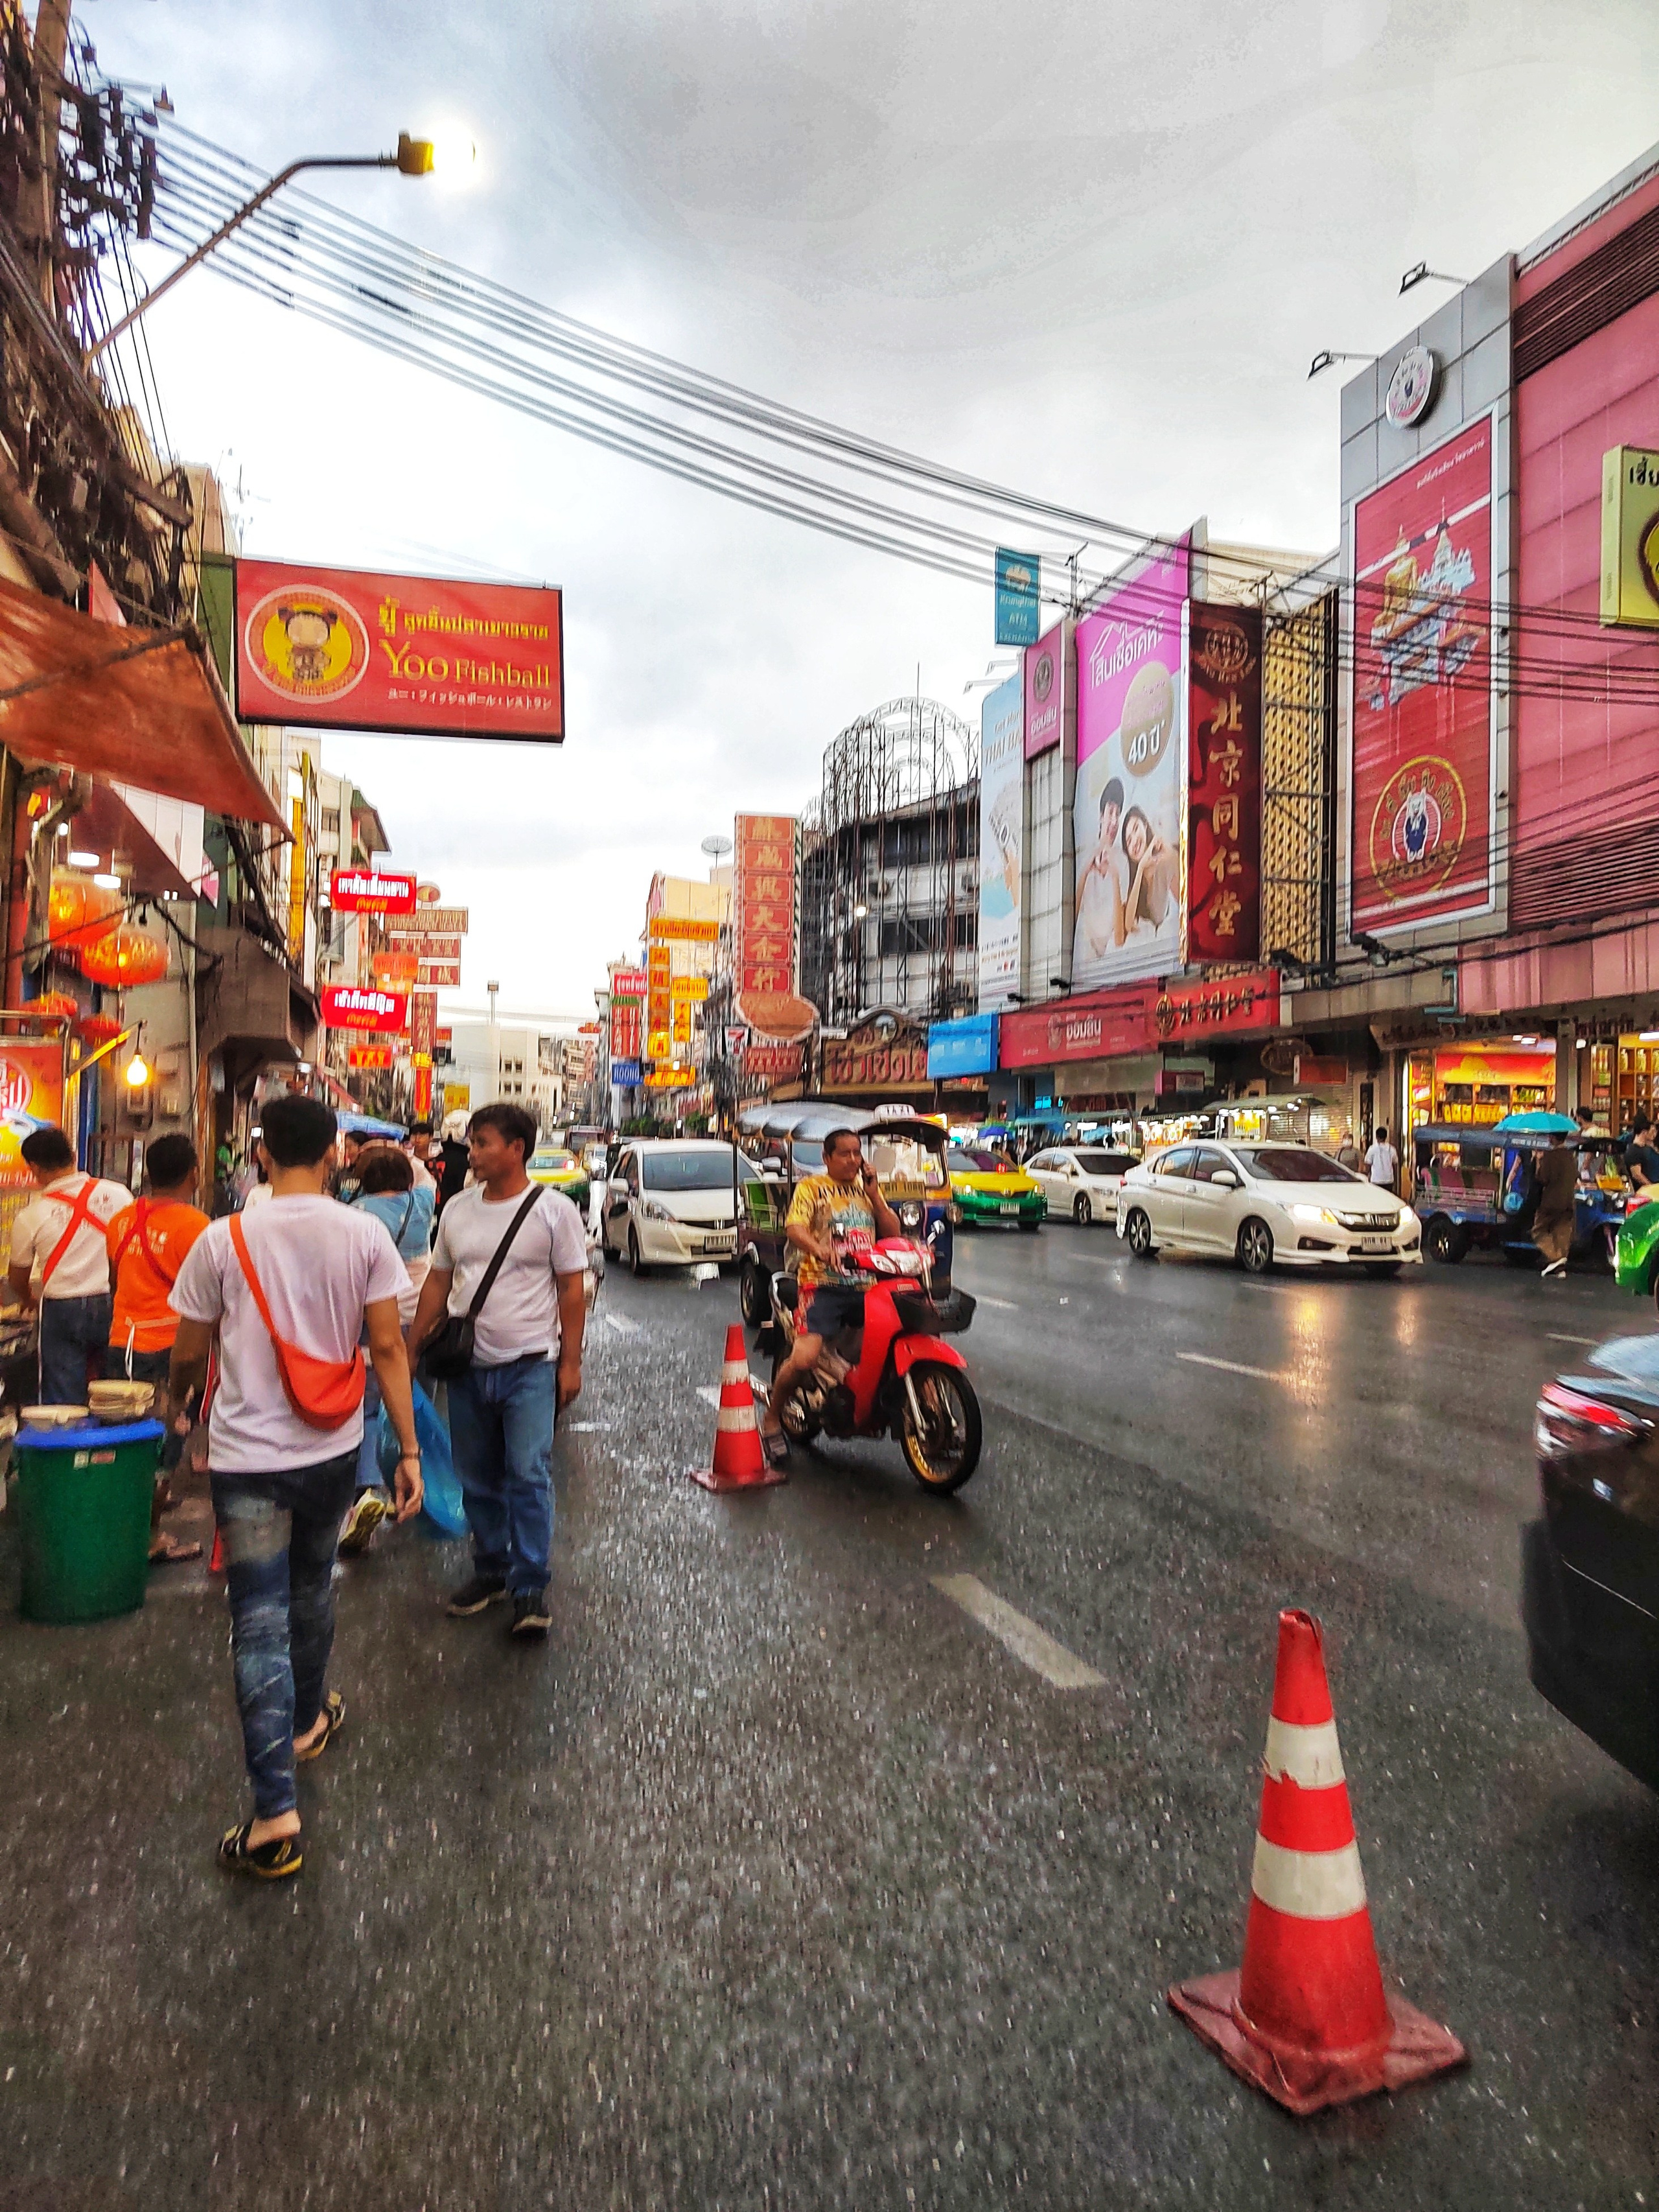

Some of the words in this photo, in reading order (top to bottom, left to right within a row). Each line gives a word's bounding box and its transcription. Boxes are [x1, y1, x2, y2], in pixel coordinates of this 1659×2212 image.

[378, 639, 449, 682] Yoo
[456, 658, 550, 689] Fishball
[1210, 691, 1244, 936] 北京同仁堂
